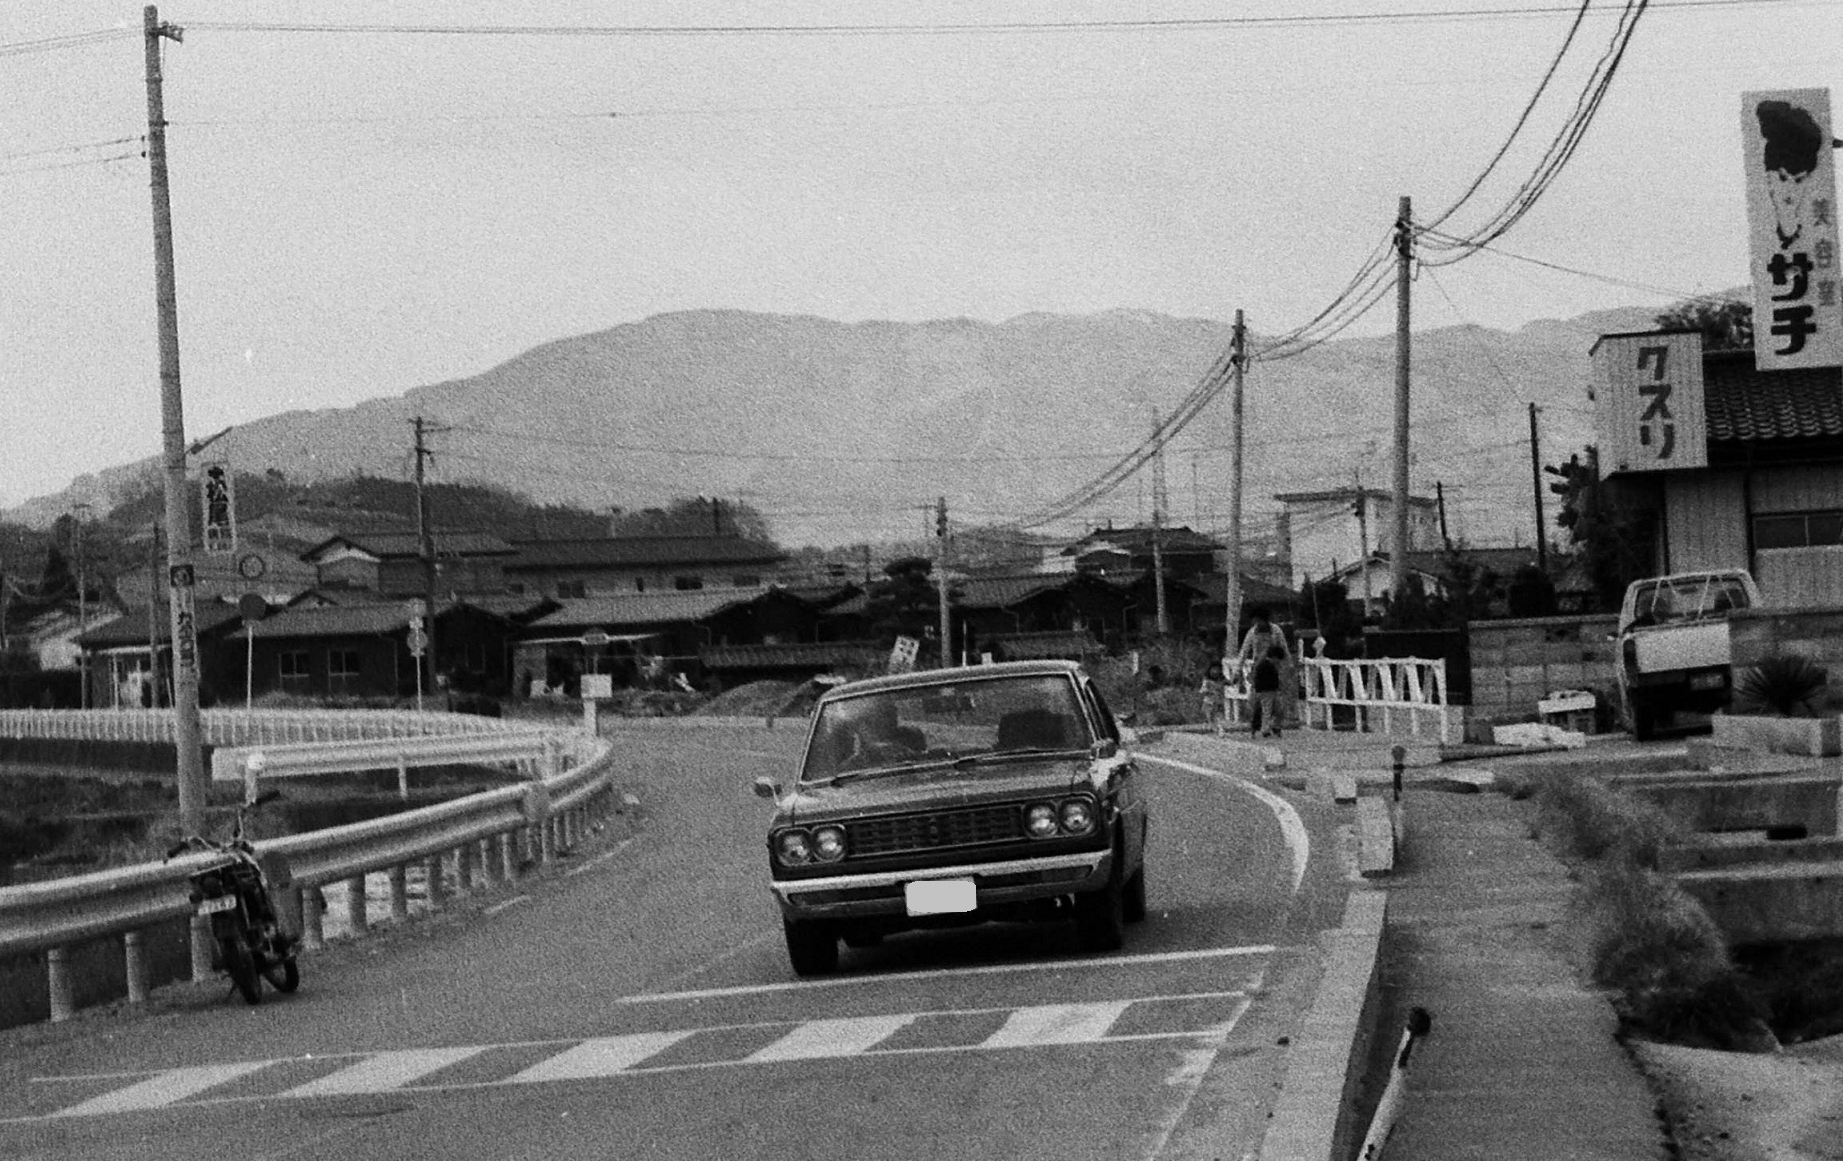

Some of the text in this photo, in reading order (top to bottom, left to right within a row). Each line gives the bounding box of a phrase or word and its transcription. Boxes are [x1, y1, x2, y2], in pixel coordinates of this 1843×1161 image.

[1766, 252, 1817, 356] サチ
[1637, 346, 1675, 459] クスリ
